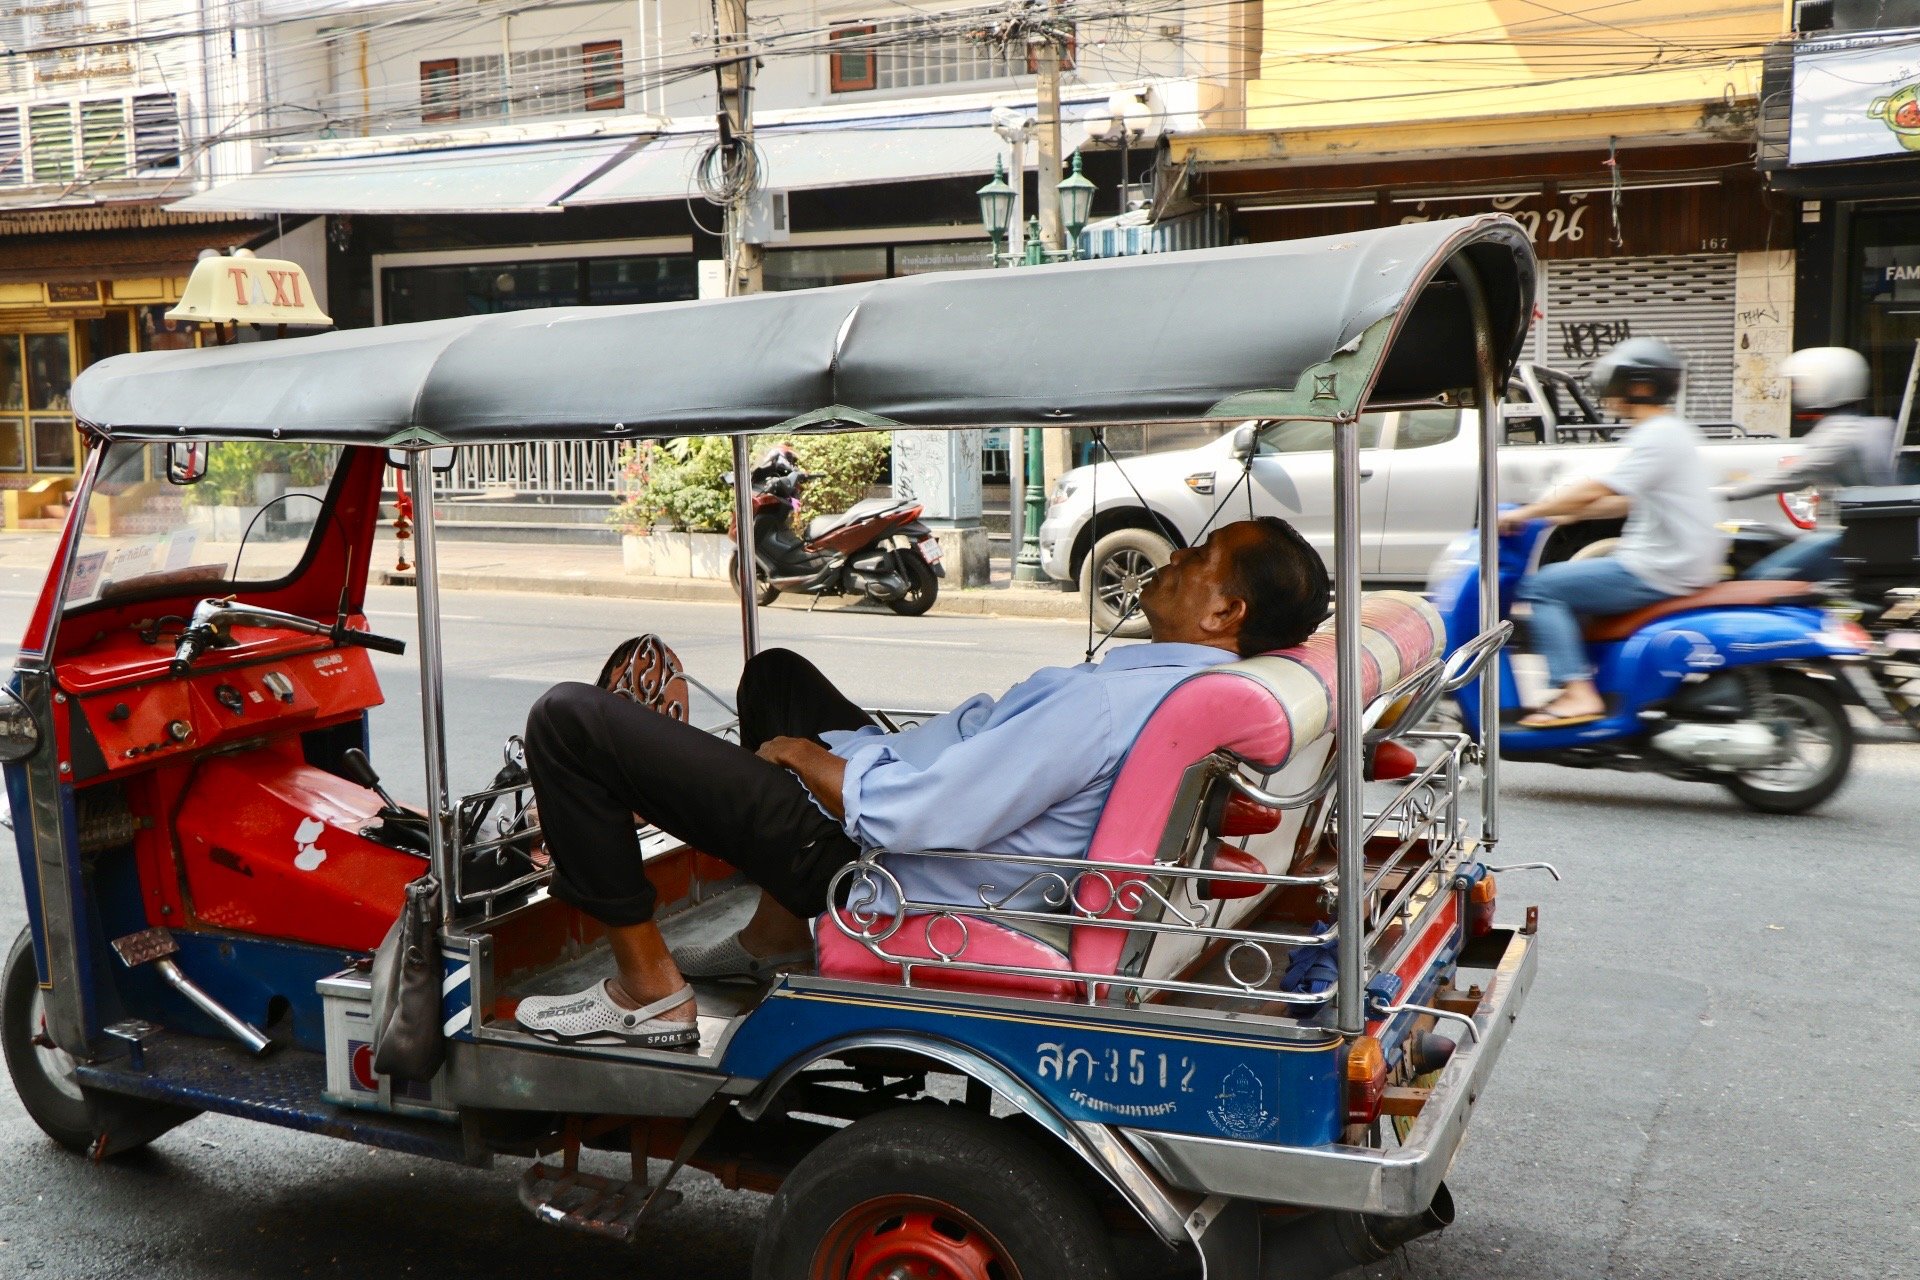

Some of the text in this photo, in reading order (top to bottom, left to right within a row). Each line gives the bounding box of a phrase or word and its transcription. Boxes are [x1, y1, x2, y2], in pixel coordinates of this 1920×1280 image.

[1702, 237, 1728, 250] 167
[228, 268, 304, 307] TAXI
[647, 1033, 682, 1044] SPORT
